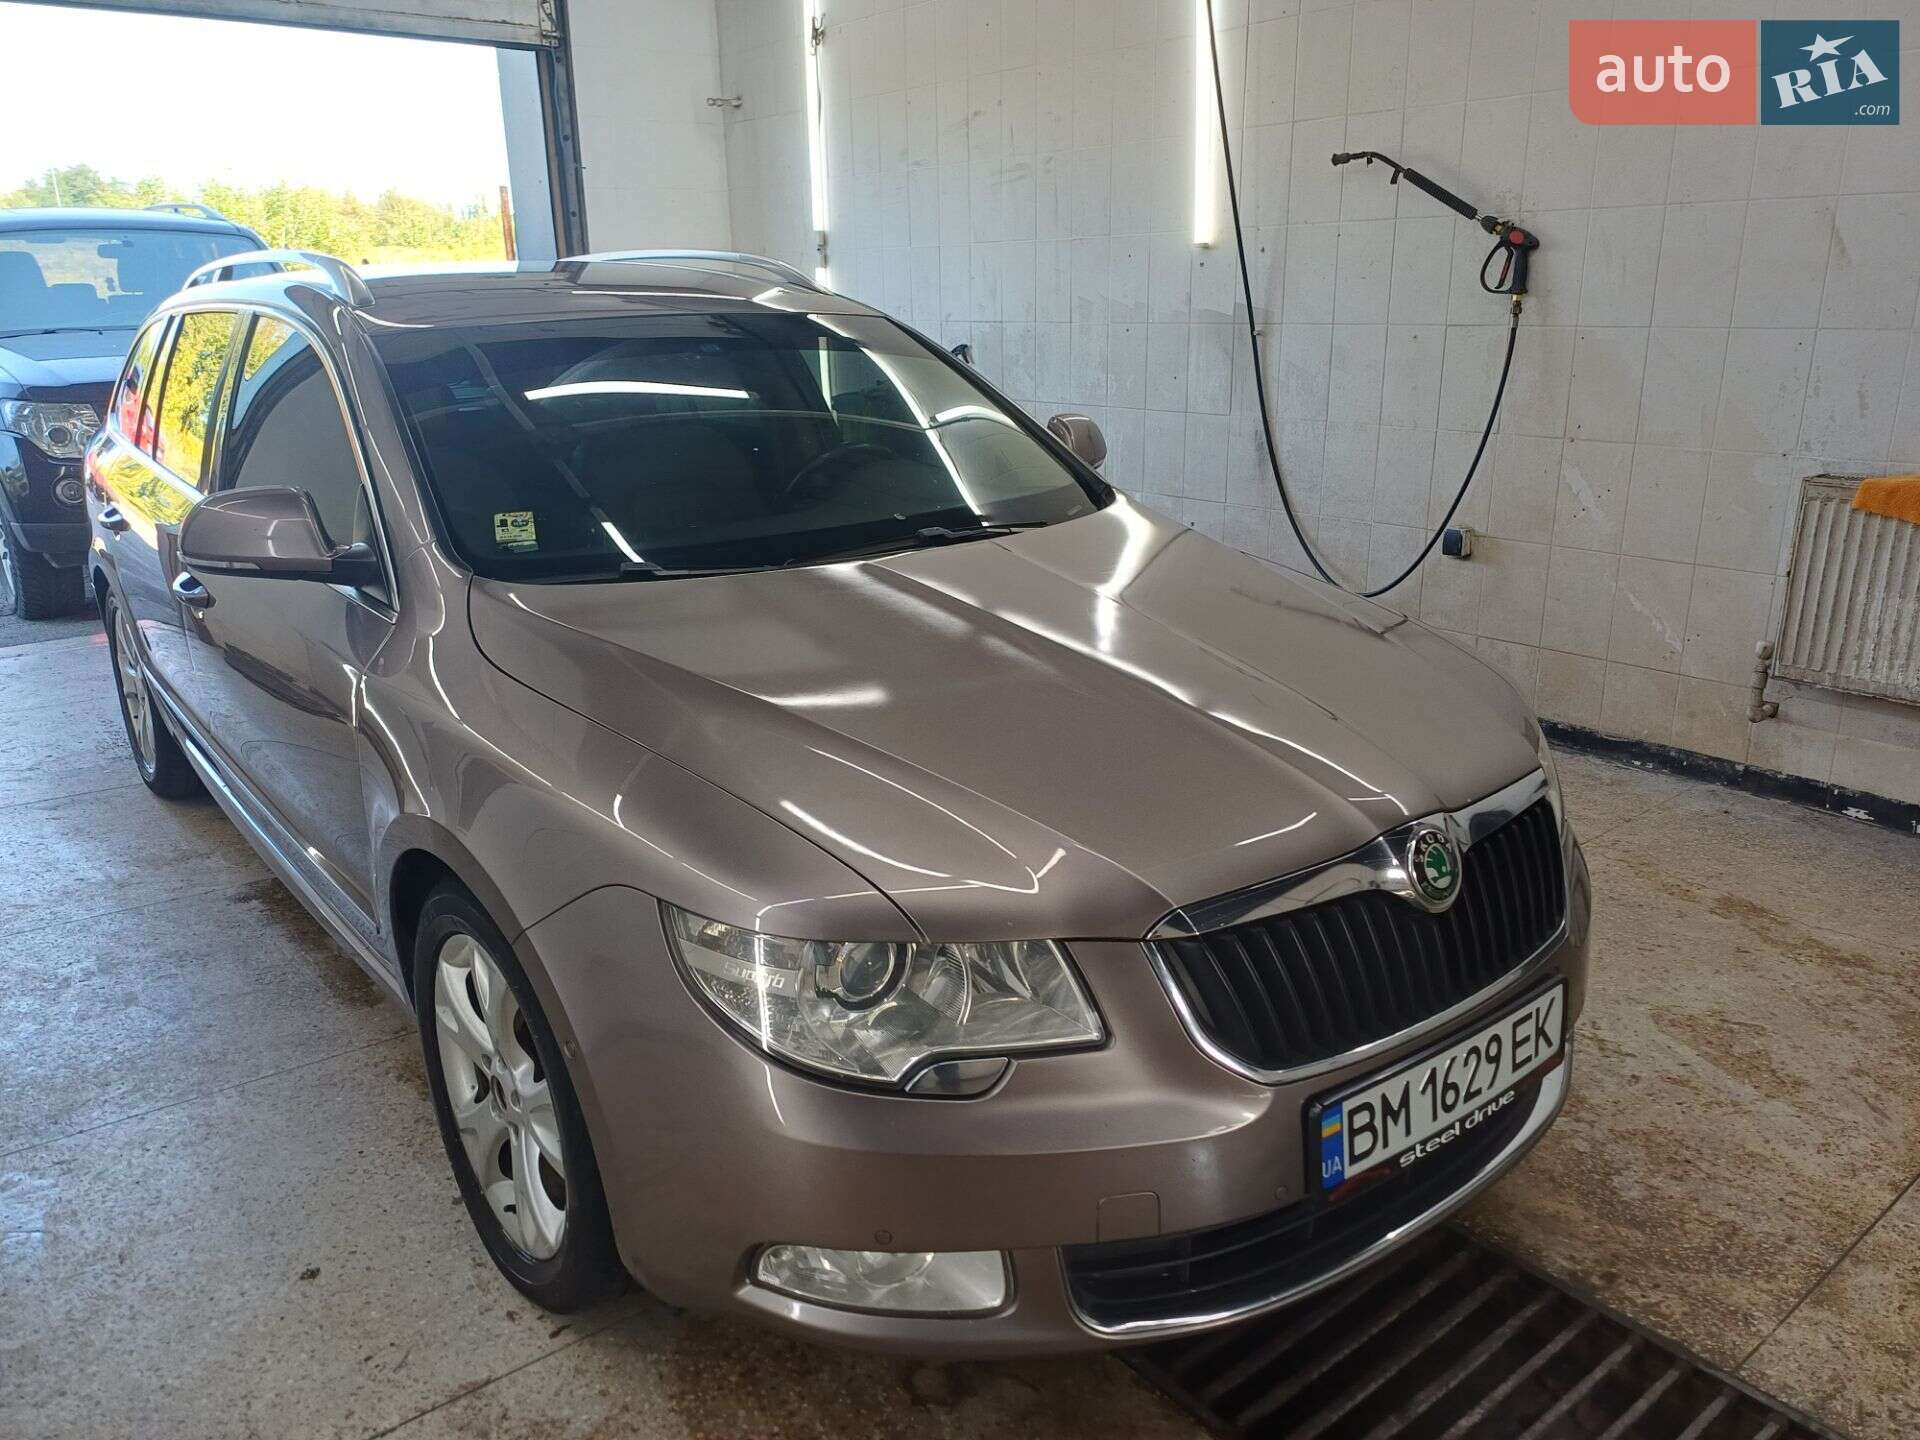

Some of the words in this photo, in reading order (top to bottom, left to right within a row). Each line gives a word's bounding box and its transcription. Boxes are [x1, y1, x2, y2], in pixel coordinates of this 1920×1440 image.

[1348, 1080, 1412, 1166] BM
[1419, 1033, 1503, 1123] 1629
[1511, 996, 1556, 1074] EK
[1321, 1155, 1343, 1179] UA
[1399, 1121, 1461, 1168] steel
[1464, 1090, 1516, 1130] drive
